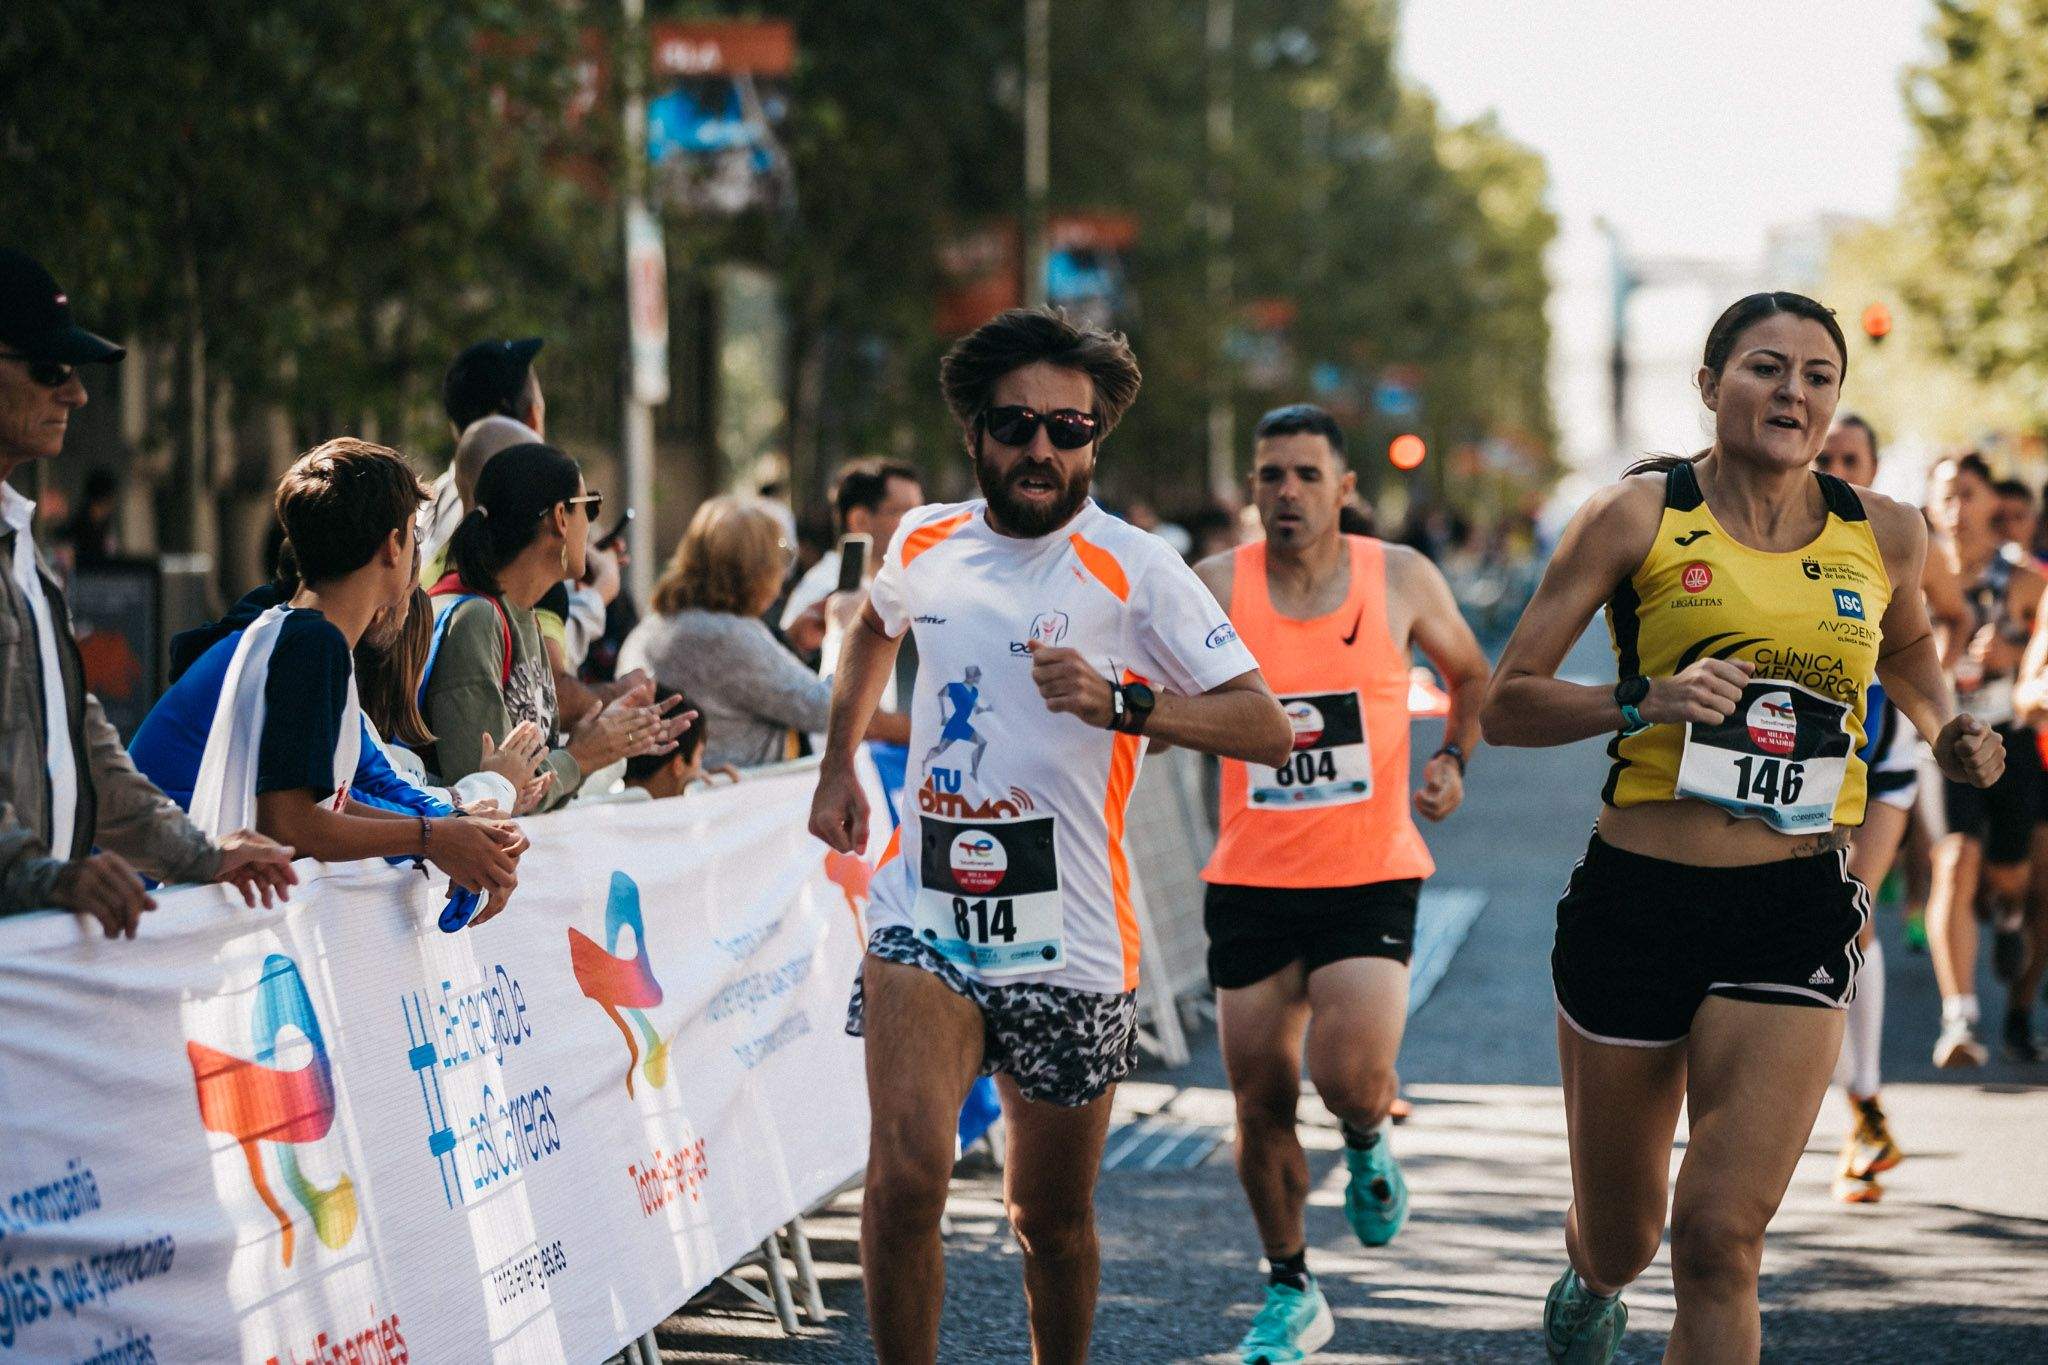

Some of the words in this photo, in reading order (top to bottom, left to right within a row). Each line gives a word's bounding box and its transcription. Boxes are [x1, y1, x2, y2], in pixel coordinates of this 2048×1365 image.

[1838, 594, 1861, 613] ISC
[1753, 646, 1845, 673] CLÍNICA
[1757, 736, 1768, 744] DE
[1767, 730, 1789, 740] MILLA
[932, 767, 961, 794] TU
[1276, 750, 1337, 787] 804
[1733, 755, 1805, 805] 146
[952, 897, 1017, 943] 814
[453, 1084, 561, 1190] LasCarreras
